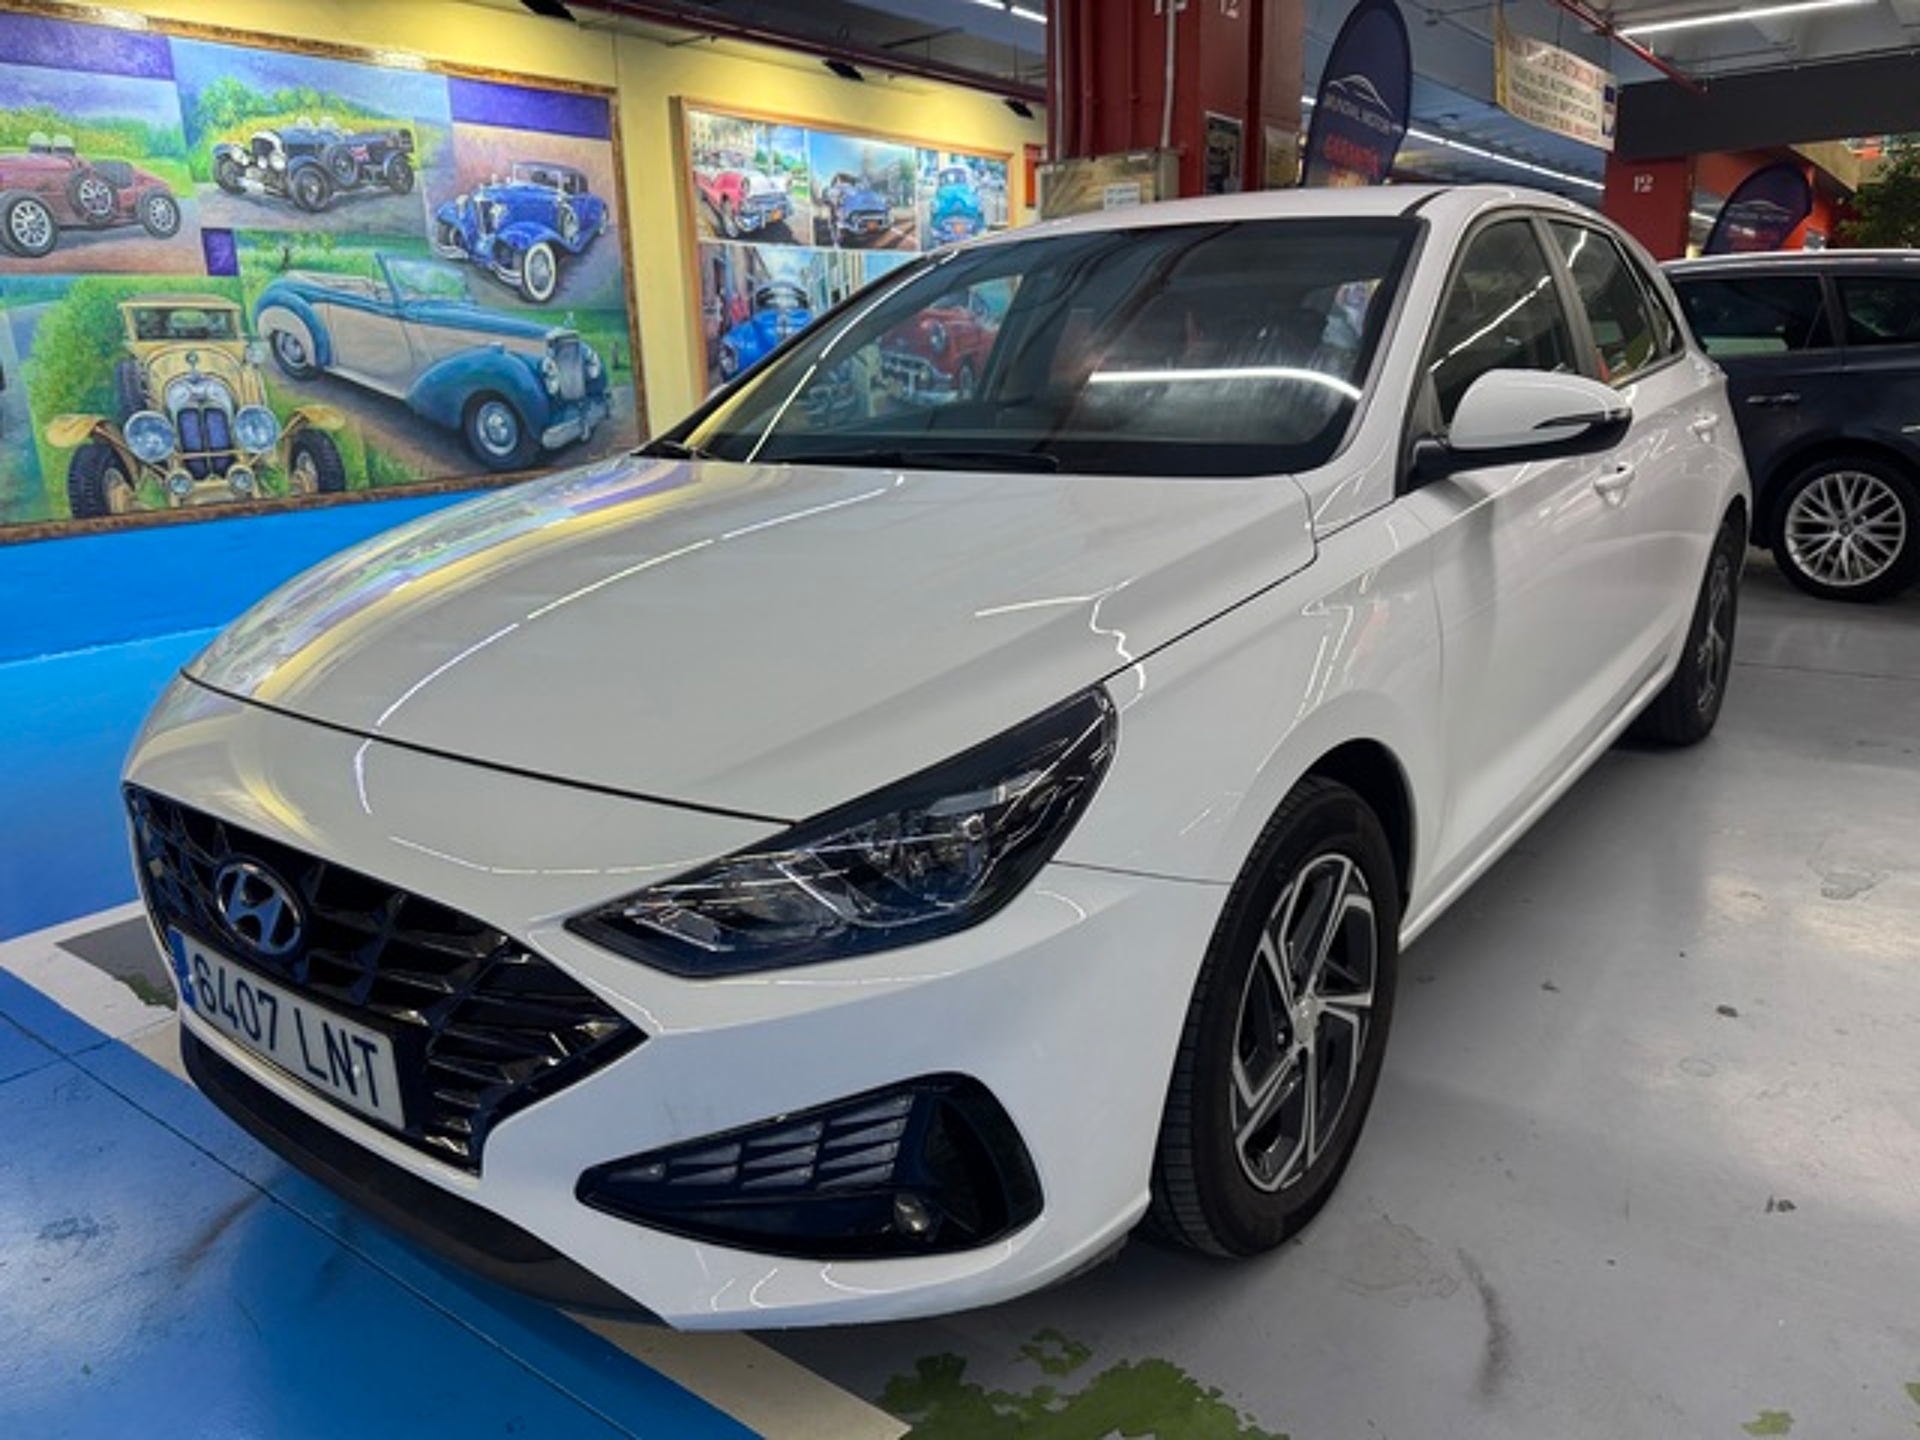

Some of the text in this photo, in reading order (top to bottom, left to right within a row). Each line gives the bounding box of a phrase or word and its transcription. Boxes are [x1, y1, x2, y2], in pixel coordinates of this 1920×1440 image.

[1634, 174, 1654, 193] 12
[194, 953, 378, 1108] 6407 LNT
